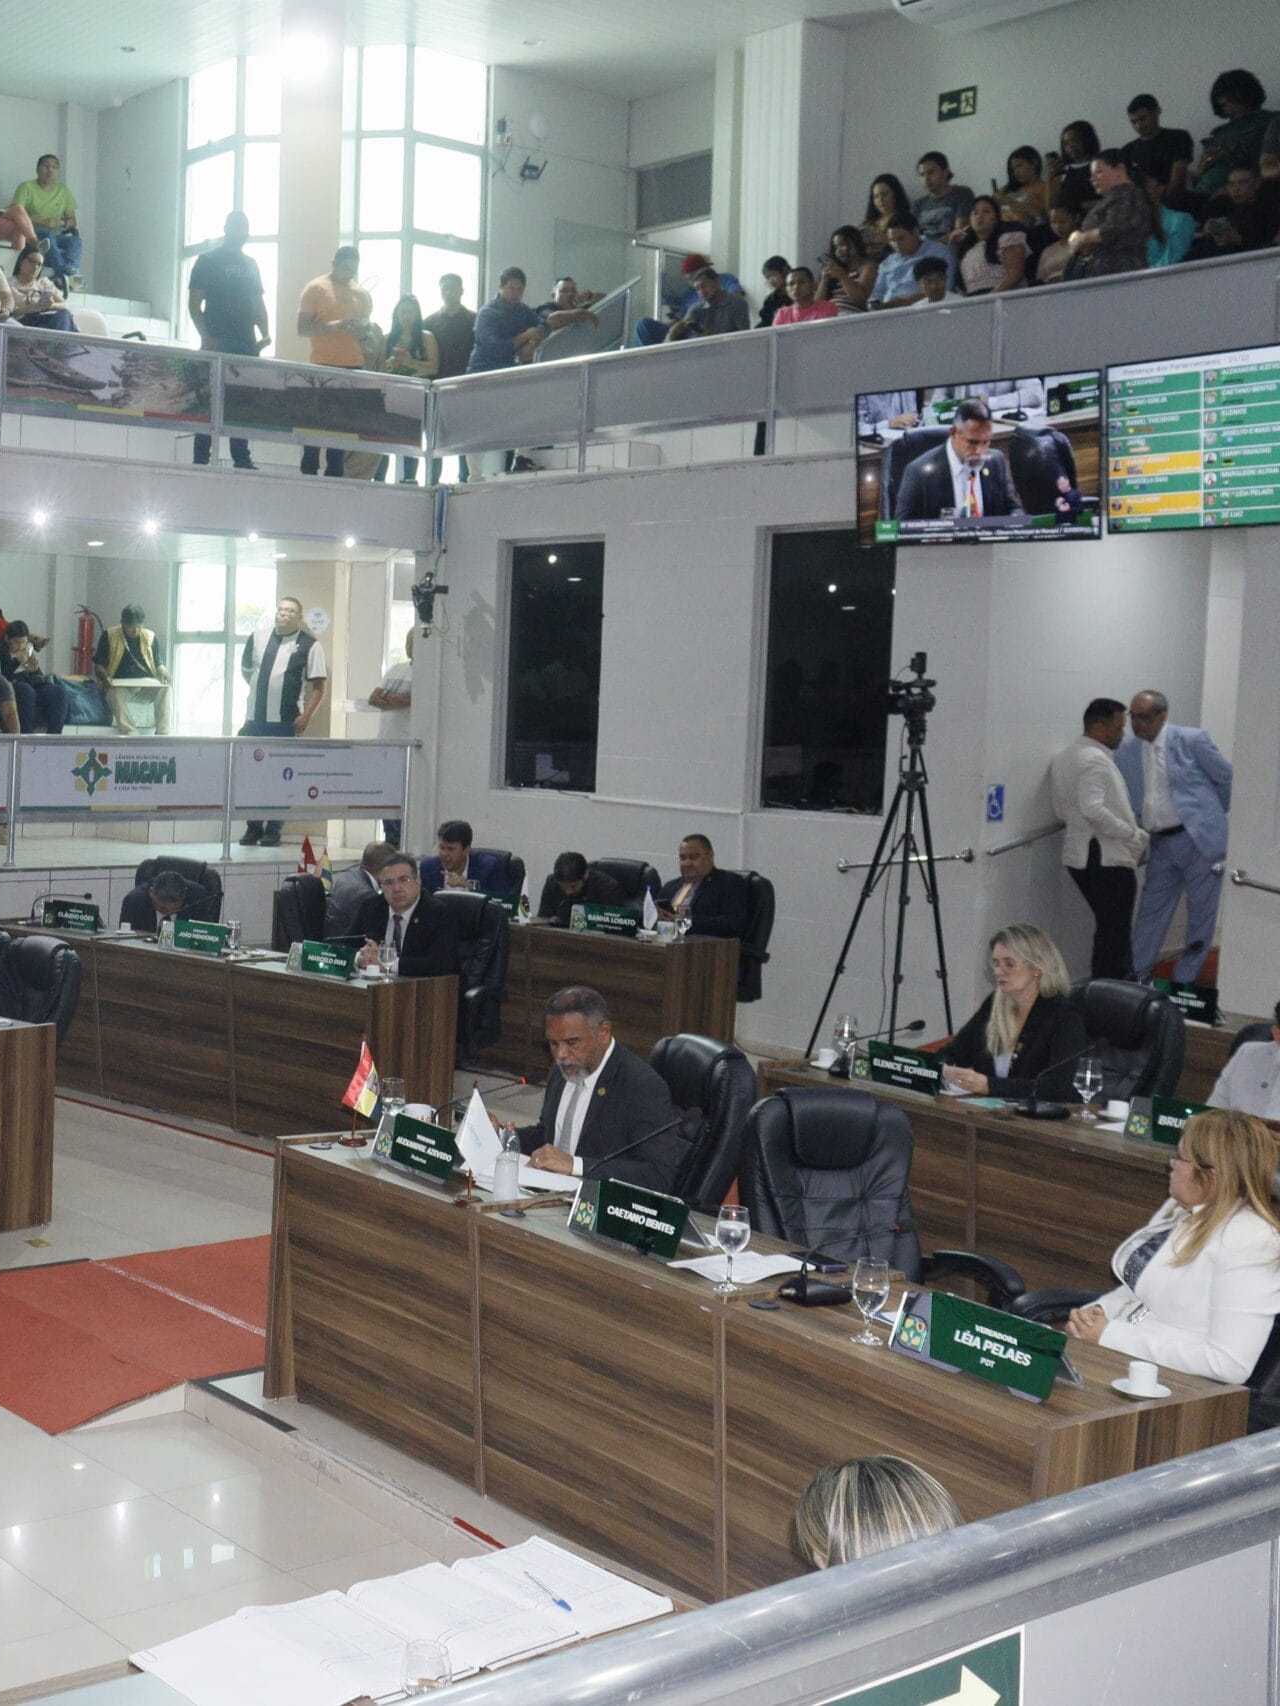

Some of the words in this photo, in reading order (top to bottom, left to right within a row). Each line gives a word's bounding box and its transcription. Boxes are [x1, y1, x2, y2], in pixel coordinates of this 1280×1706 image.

[114, 756, 177, 784] MACAPÁ
[611, 917, 636, 926] LOBATO
[872, 1057, 902, 1073] ELENICE
[903, 1065, 939, 1080] SCHERER
[395, 1135, 428, 1154] ALEXANDRE
[426, 1147, 453, 1163] AZEVEDO
[607, 1205, 646, 1226] CAETANO
[644, 1217, 676, 1236] BENTES
[975, 1324, 1018, 1345] VEREADORA
[954, 1329, 981, 1349] LÉIA
[982, 1340, 1033, 1367] PELAES
[980, 1356, 995, 1368] PDT
